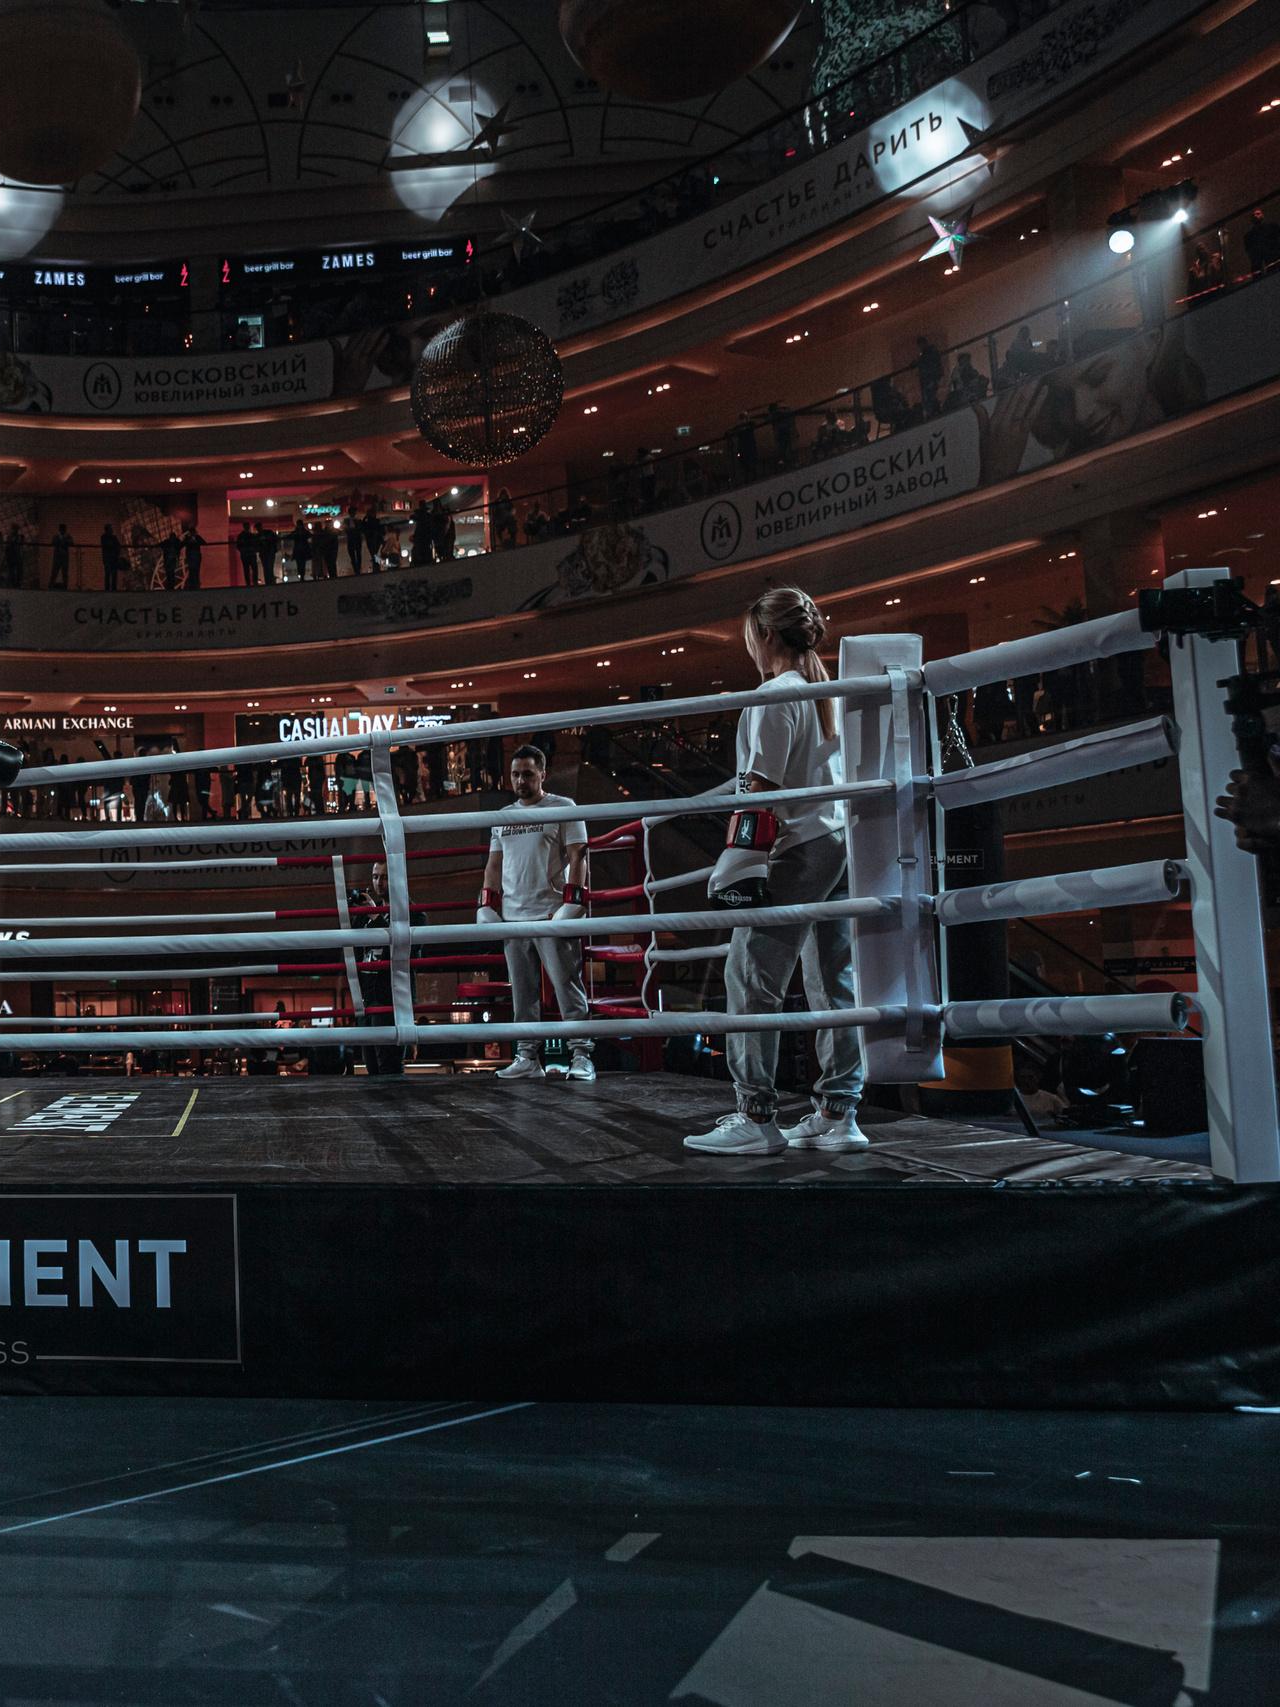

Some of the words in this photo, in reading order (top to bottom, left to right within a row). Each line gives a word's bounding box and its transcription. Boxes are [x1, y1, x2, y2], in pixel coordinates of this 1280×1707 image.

[703, 180, 817, 249] СЧАСТЬЕ
[833, 111, 943, 189] ДАРИТЬ
[322, 252, 375, 270] ZAMES
[402, 251, 421, 261] beer
[438, 247, 454, 258] bar
[114, 274, 133, 284] beer
[150, 271, 164, 281] bar
[244, 264, 263, 273] beer
[281, 261, 295, 271] bar
[34, 270, 86, 287] ZAMES
[134, 353, 307, 387] МОСКОВСКИЙ
[134, 383, 245, 403] ЮВЕЛИРНЫЙ
[251, 378, 308, 397] ЗАВОД
[754, 430, 947, 520] МОСКОВСКИЙ
[756, 487, 877, 541] ЮВЕЛИРНЫЙ
[883, 466, 948, 501] ЗАВОД
[74, 606, 183, 625] СЧАСТЬЕ
[198, 600, 299, 625] ДАРИТЬ
[3, 717, 56, 730] ARMANI
[62, 716, 134, 730] EXCHANGE
